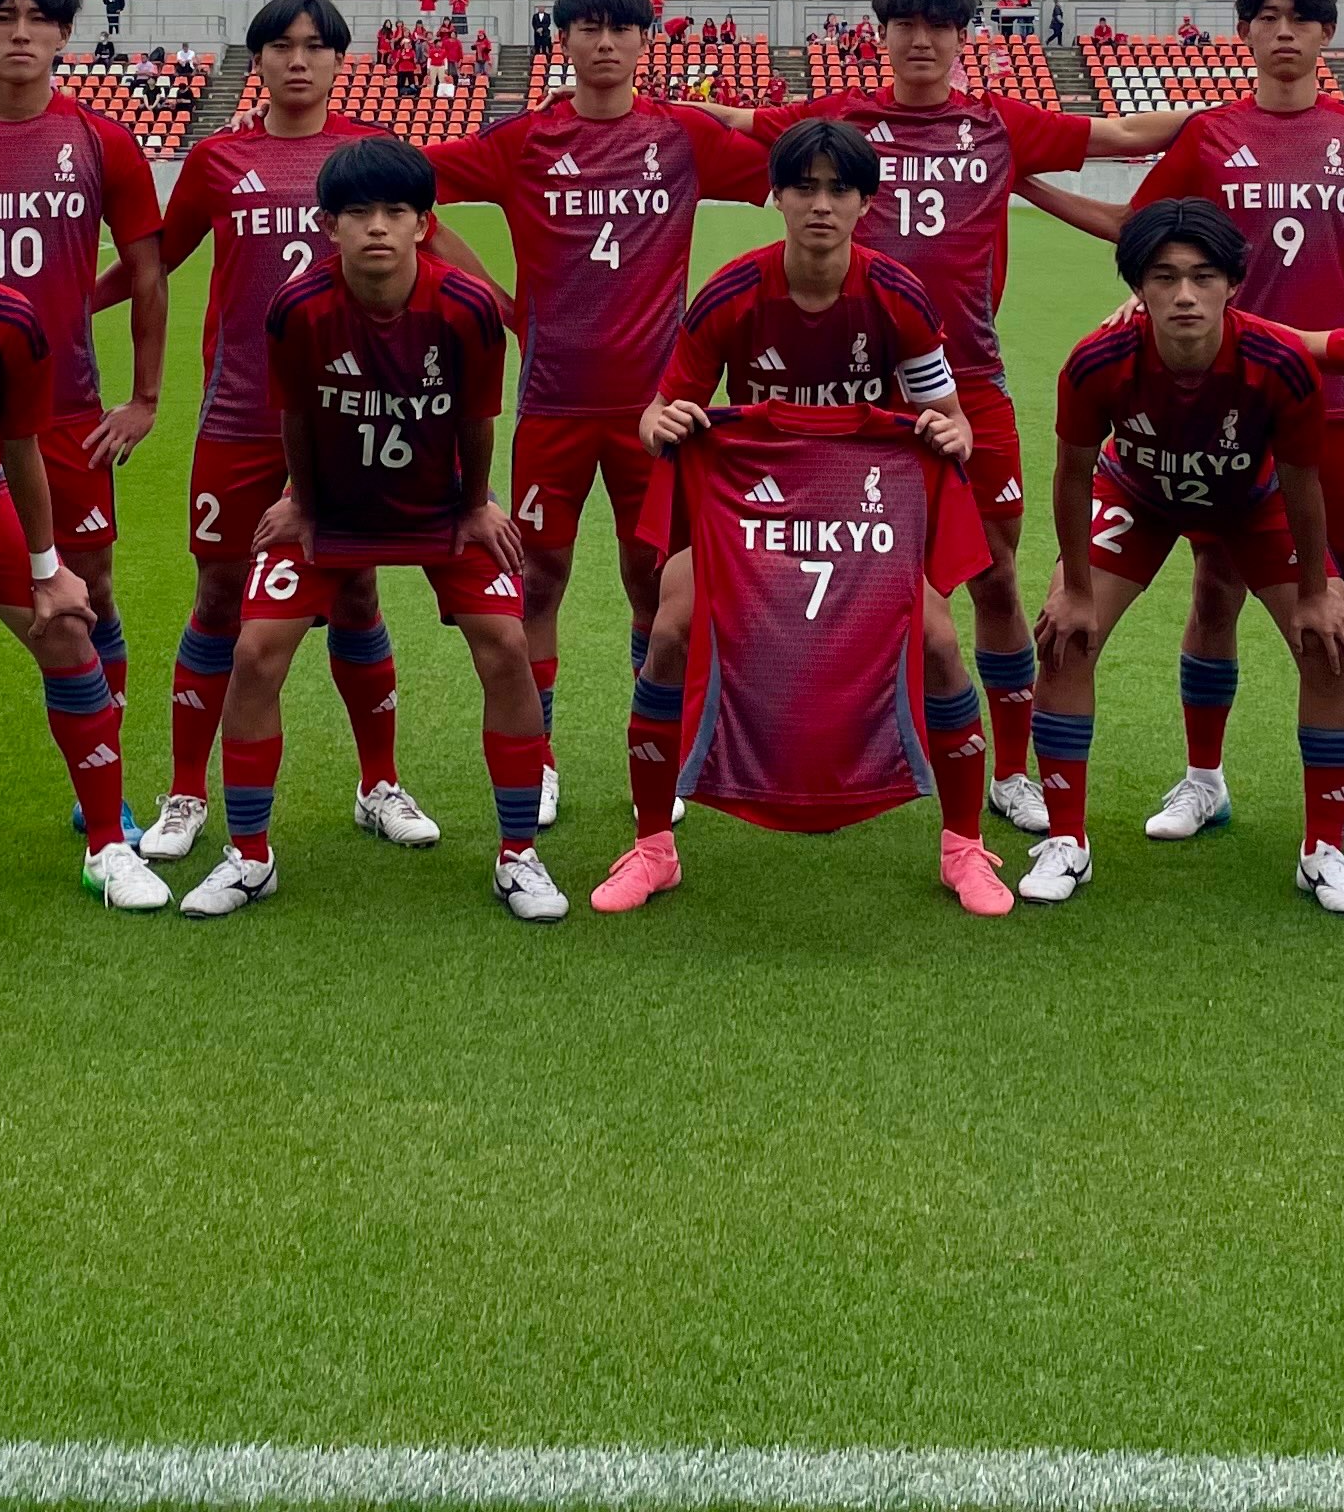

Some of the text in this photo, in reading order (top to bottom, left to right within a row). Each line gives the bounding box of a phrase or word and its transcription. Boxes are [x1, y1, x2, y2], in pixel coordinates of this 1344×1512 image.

[895, 189, 945, 236] 13
[283, 241, 312, 282] 2
[590, 222, 619, 269] 4
[1273, 217, 1304, 266] 9
[358, 424, 412, 468] 16
[519, 485, 543, 530] 4
[1154, 475, 1213, 506] 12
[196, 493, 221, 541] 2
[249, 552, 299, 599] 16
[800, 561, 833, 619] 7
